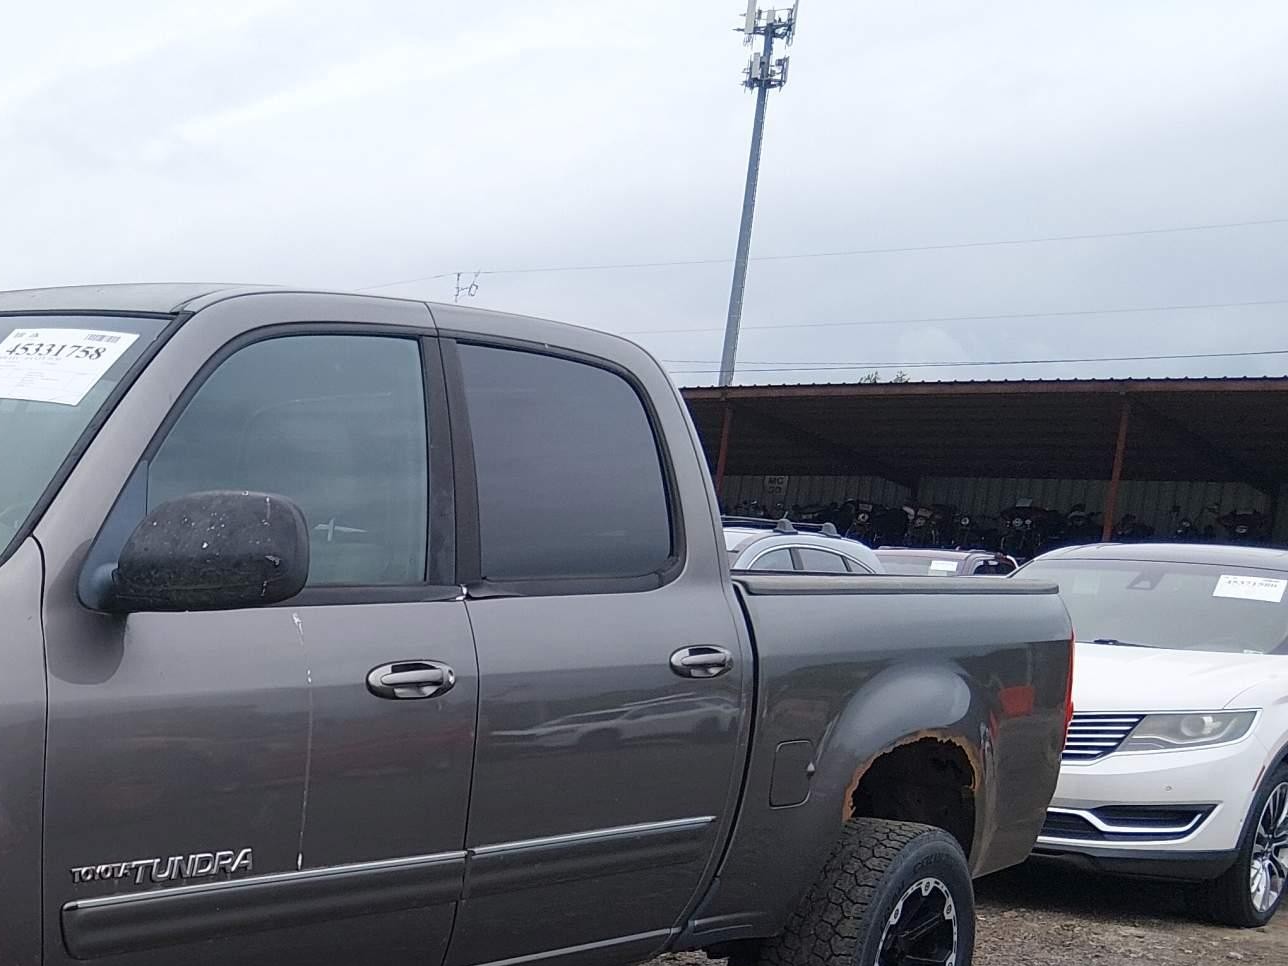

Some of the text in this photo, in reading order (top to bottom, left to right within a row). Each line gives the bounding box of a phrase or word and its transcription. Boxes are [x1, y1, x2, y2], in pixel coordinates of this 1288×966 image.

[5, 342, 107, 361] 45331758
[71, 848, 253, 884] TOYOTA TUNDRA
